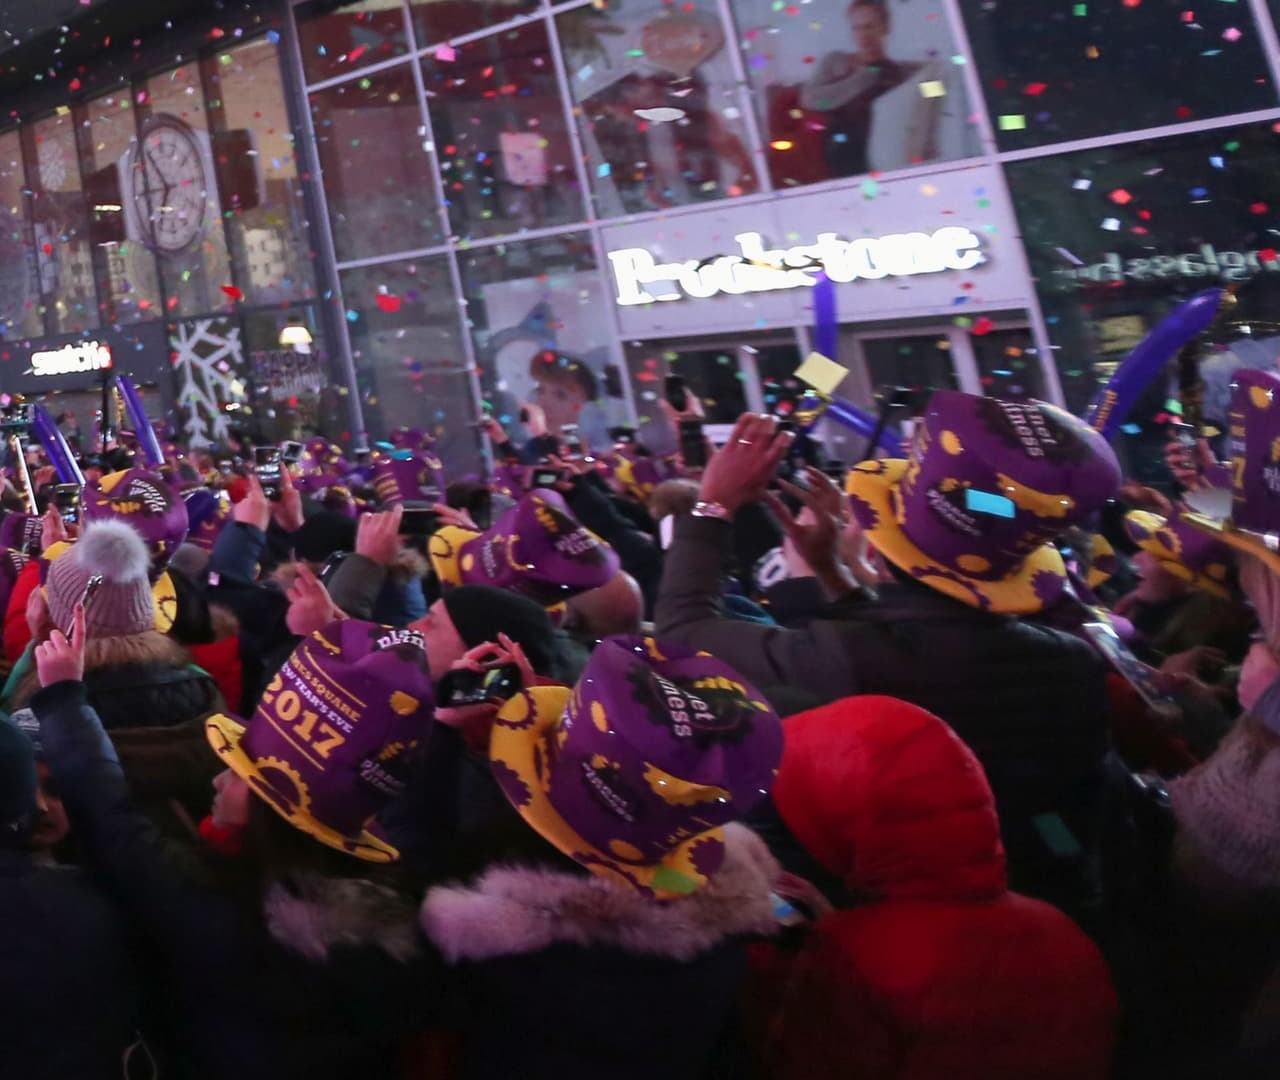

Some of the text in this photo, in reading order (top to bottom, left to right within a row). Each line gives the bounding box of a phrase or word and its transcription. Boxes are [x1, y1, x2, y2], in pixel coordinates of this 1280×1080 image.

[263, 672, 346, 759] 2017
[281, 661, 354, 733] EW YEAR'S EVE
[310, 674, 362, 722] SQUARE
